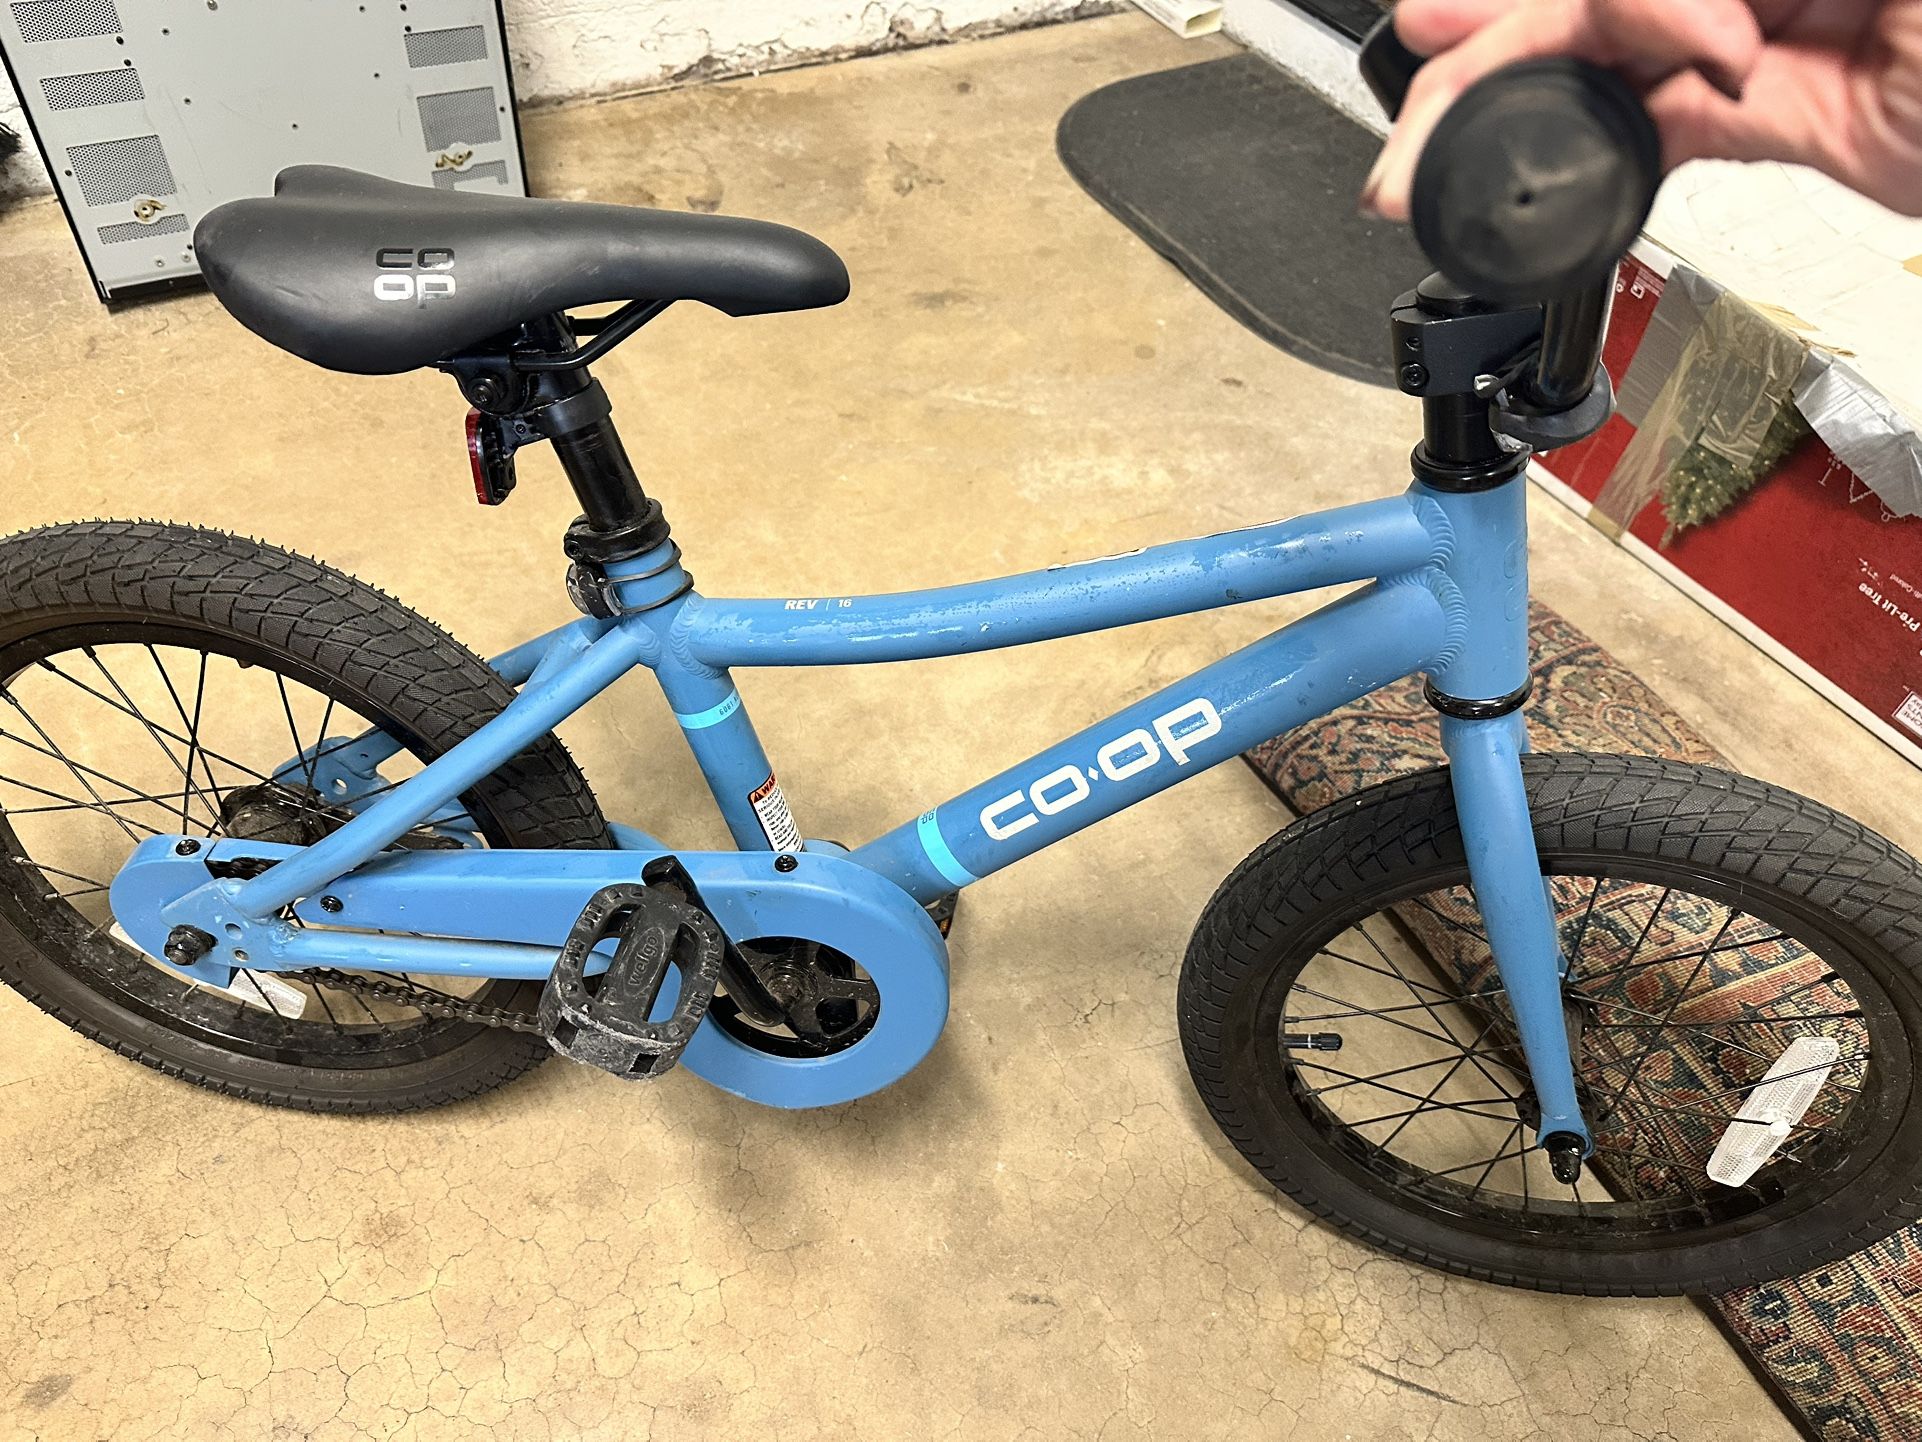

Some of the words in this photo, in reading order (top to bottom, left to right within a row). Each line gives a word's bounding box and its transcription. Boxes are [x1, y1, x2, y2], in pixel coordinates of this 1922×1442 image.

[784, 599, 818, 610] REV
[838, 599, 852, 608] 16
[1859, 583, 1882, 605] Tree
[1882, 599, 1921, 632] Pre-Lit
